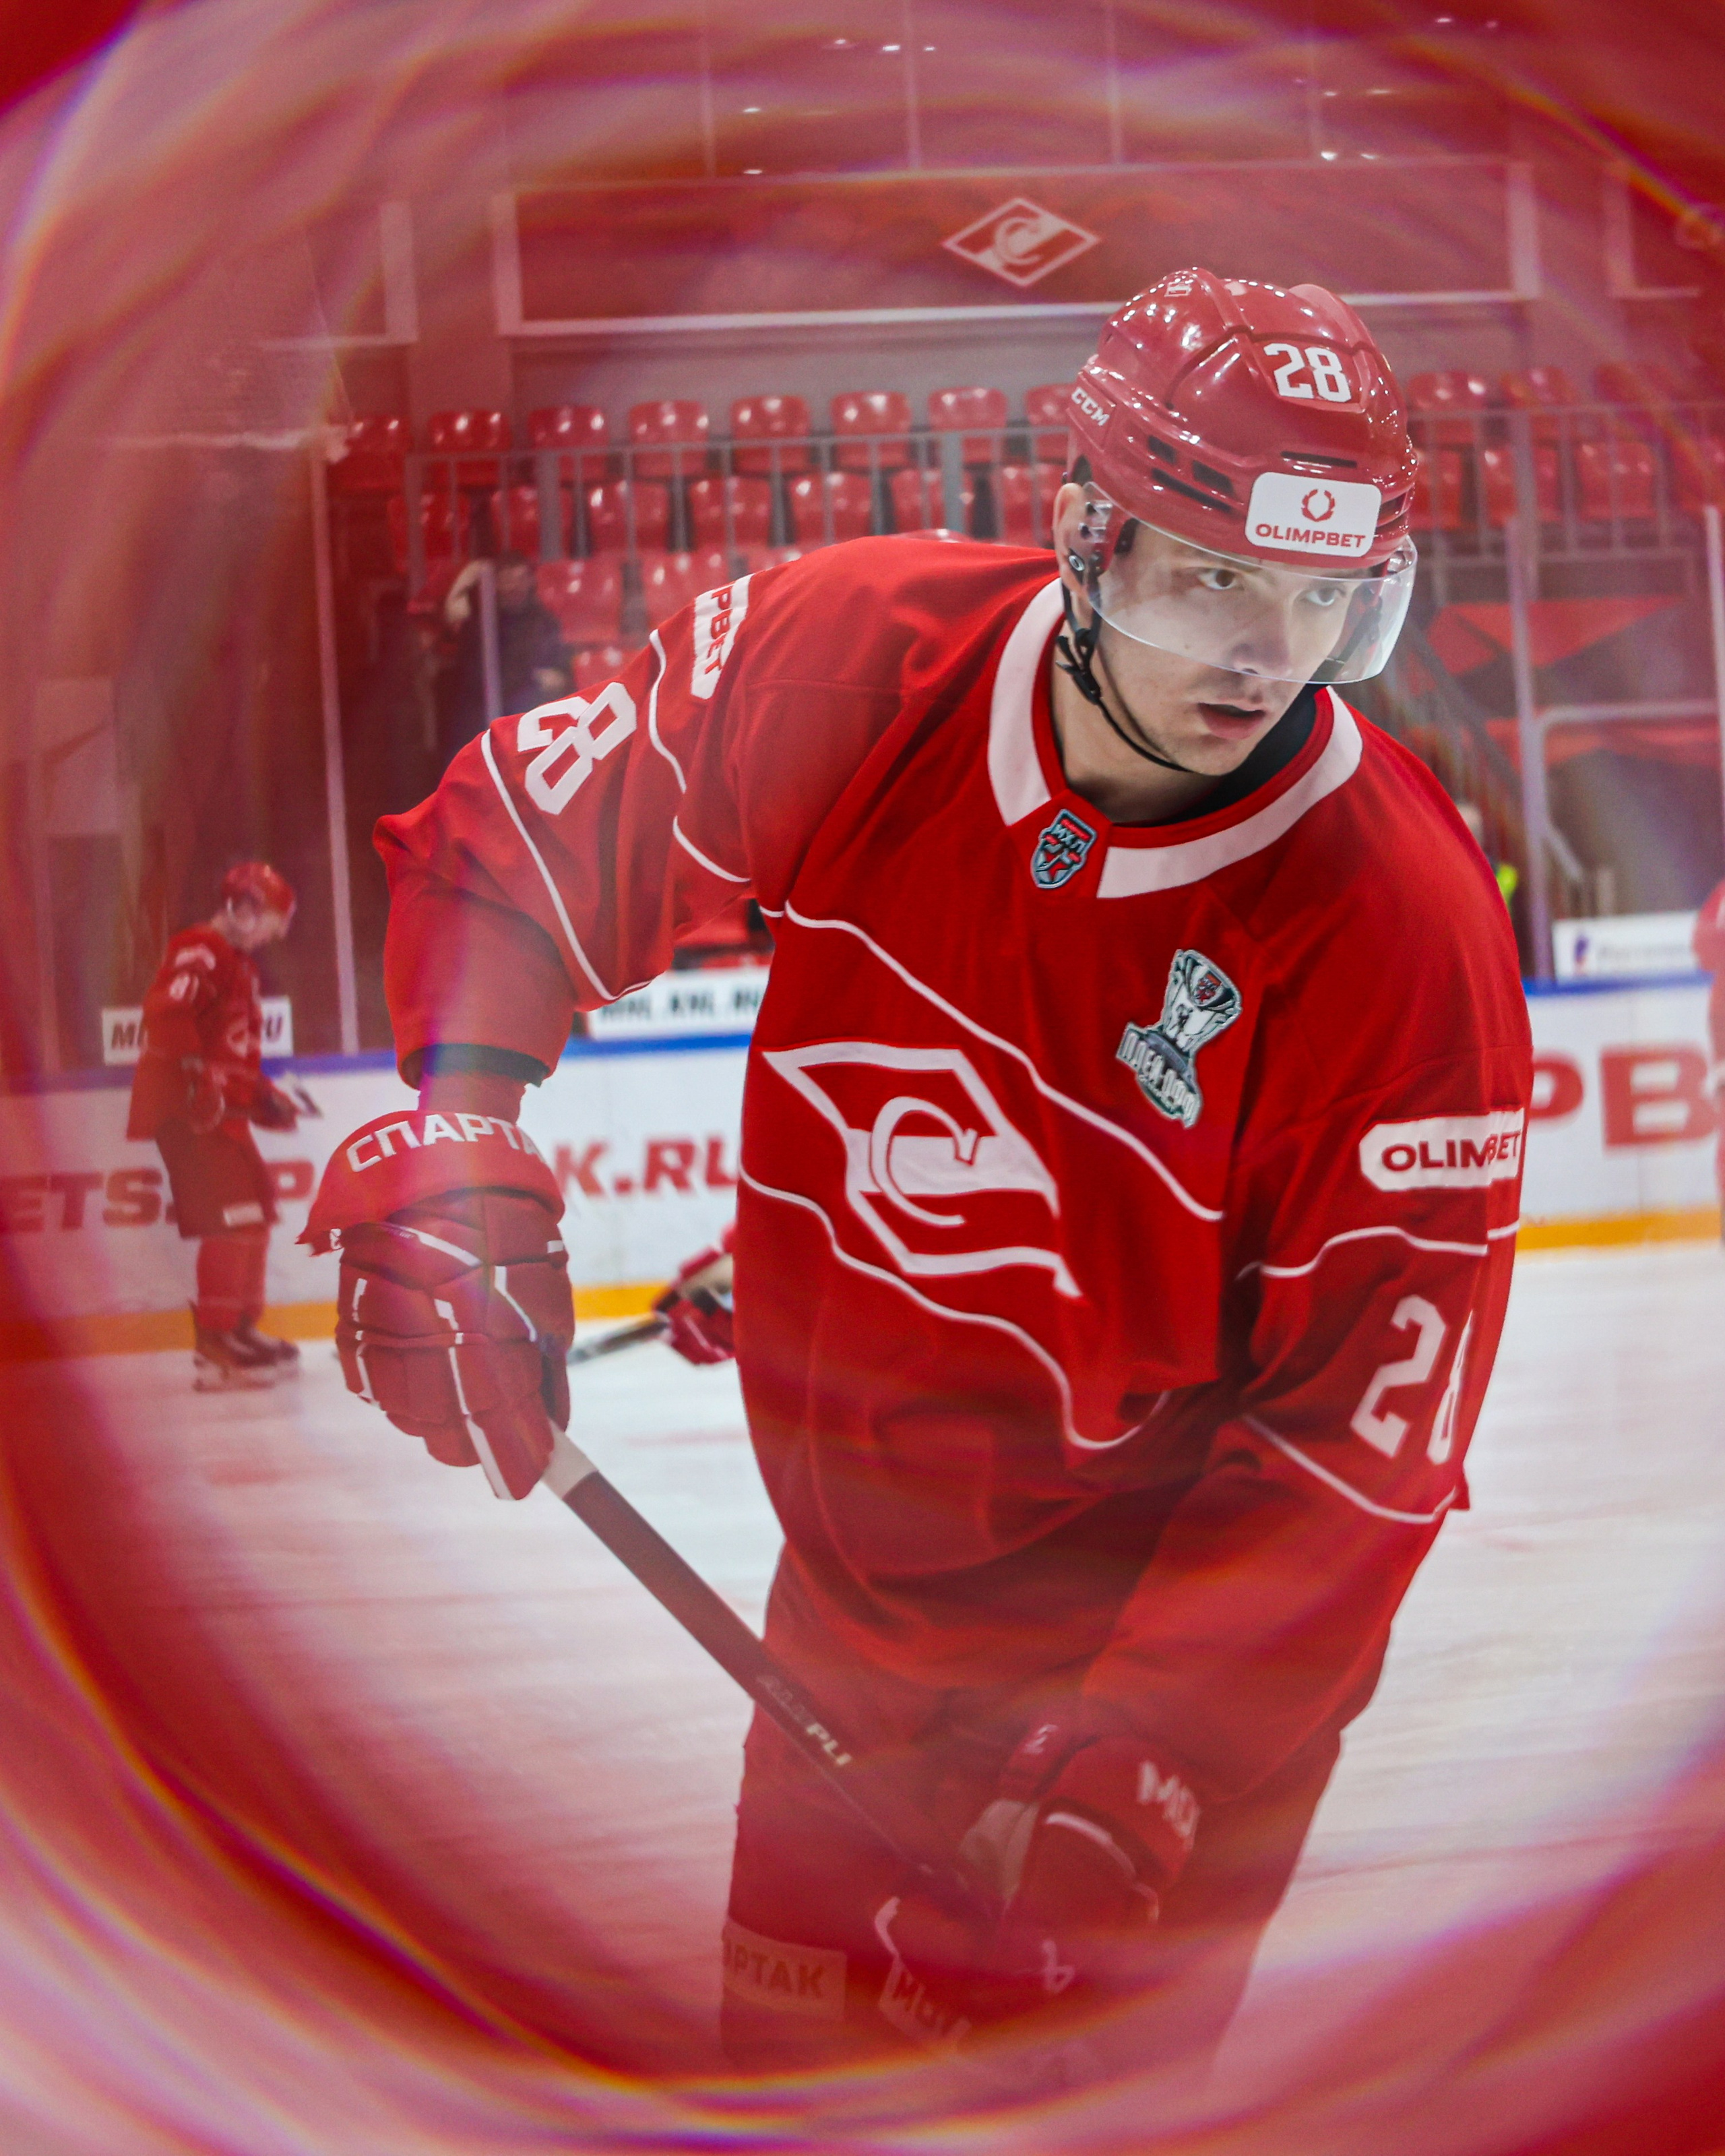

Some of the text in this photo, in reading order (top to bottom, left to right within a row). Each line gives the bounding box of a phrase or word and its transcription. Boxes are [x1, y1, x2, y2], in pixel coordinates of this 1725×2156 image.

[1264, 342, 1352, 403] 28
[1071, 386, 1110, 427] CCM
[1255, 522, 1367, 549] OLIMPBET
[1381, 1129, 1522, 1172] OLIMBET
